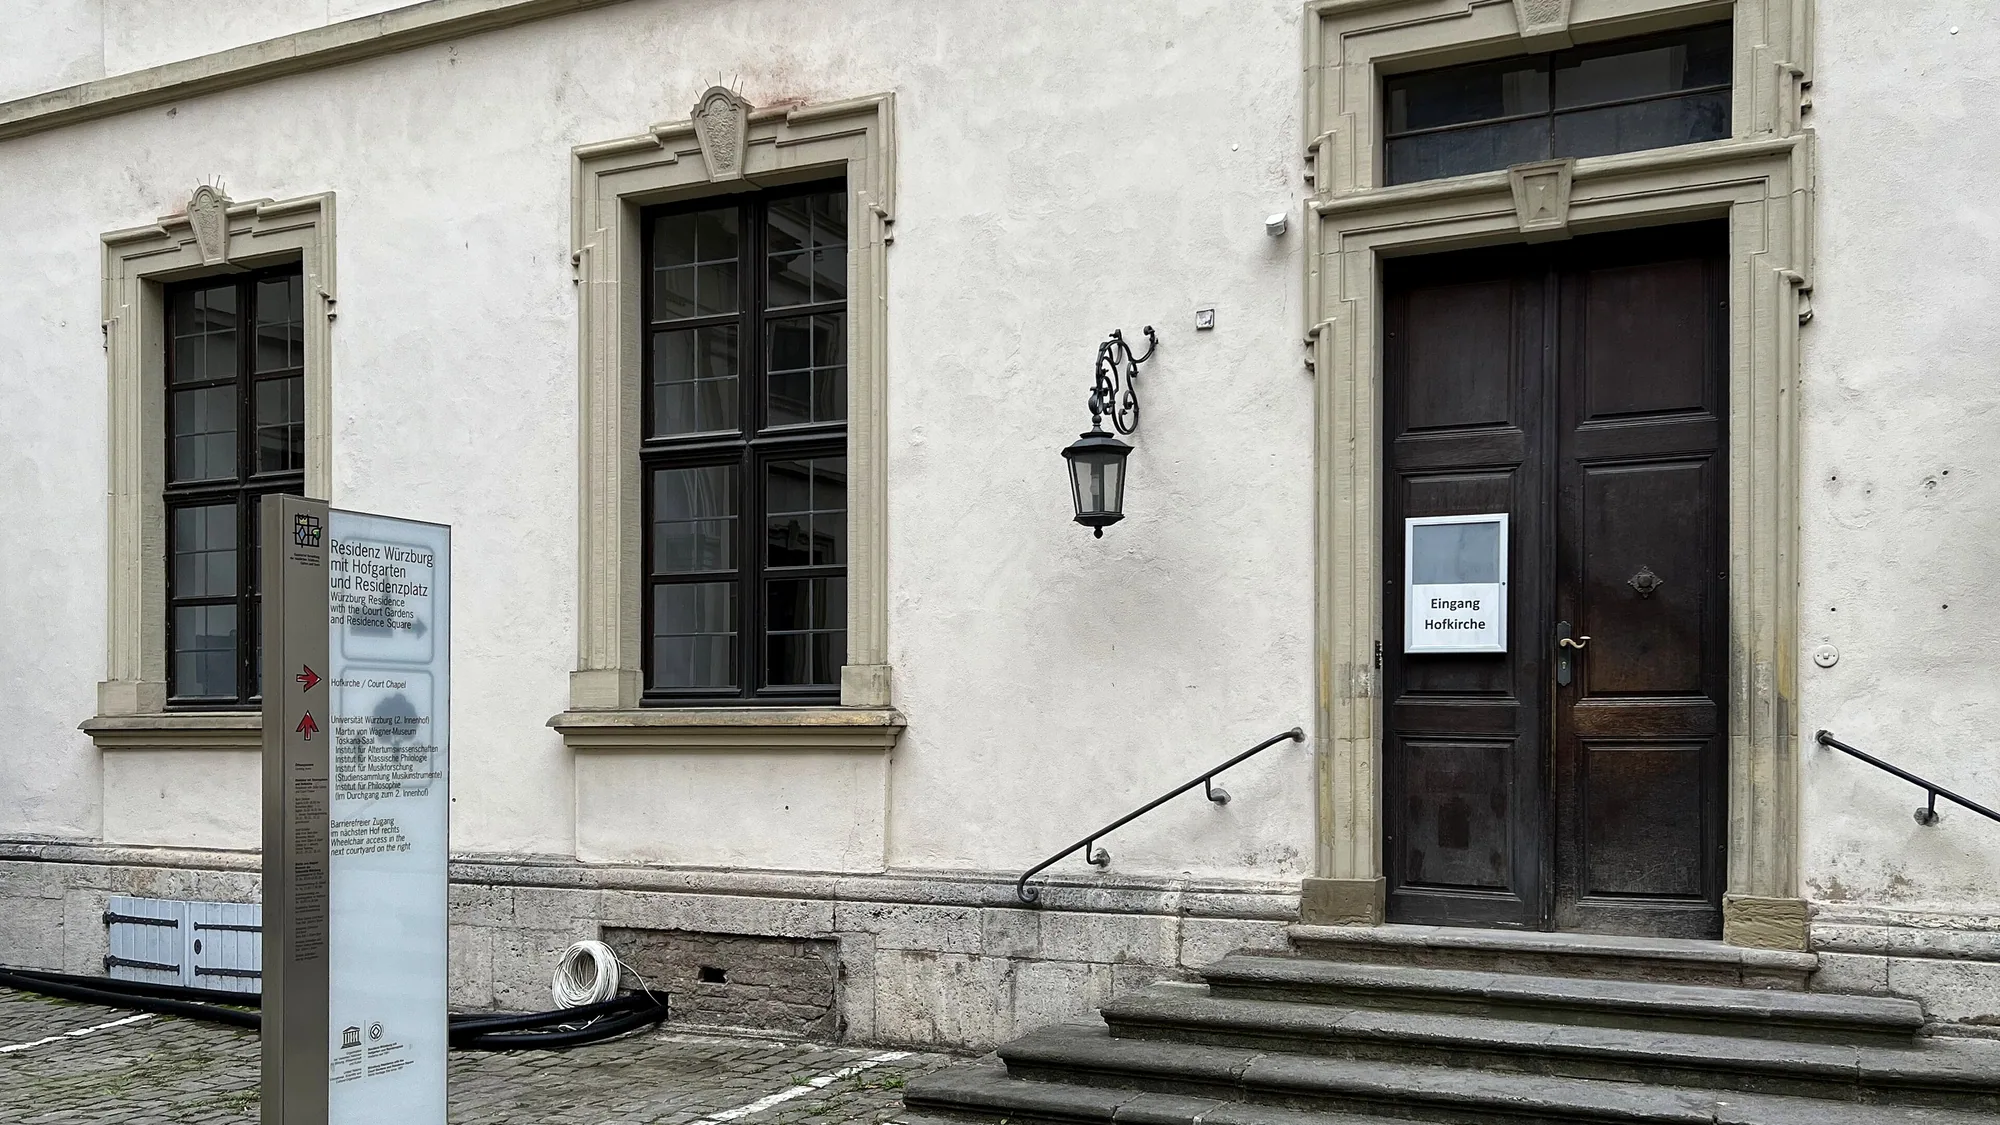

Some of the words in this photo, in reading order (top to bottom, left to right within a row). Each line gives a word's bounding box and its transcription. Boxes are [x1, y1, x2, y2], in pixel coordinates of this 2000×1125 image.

[331, 539, 380, 559] Residenz
[384, 546, 433, 567] Würzburg
[331, 558, 348, 572] mit
[353, 559, 405, 578] Hofgarten
[331, 576, 350, 589] und
[356, 576, 428, 597] Residenzplatz
[331, 592, 365, 605] Würzburg
[369, 595, 405, 607] Residence
[1431, 598, 1480, 611] Eingang
[331, 603, 345, 613] with
[348, 605, 359, 614] the
[362, 606, 382, 616] Court
[385, 607, 413, 618] Gardens
[331, 616, 344, 624] and
[347, 616, 384, 627] Residence
[387, 619, 411, 630] Square
[1425, 618, 1485, 629] Hofkirche
[331, 679, 360, 687] Hofkirche
[386, 680, 406, 689] Chapel
[331, 716, 363, 724] Universität
[365, 716, 392, 725] Würzburg
[404, 716, 429, 724] Innenhof)
[369, 728, 416, 737] Wagner-Museum
[368, 745, 438, 753] Altertumswissenschaften
[358, 755, 366, 763] für
[368, 754, 399, 762] Klassische
[401, 754, 427, 762] Philologie
[368, 764, 413, 772] Musikforschung
[335, 773, 390, 781] (Studiensammlung
[392, 771, 442, 779] Musikinstrumente)
[368, 782, 401, 790] Philosophie
[347, 791, 379, 800] Durchgang
[403, 788, 428, 797] Innenhof)
[331, 819, 370, 828] Barrierefreier
[373, 818, 394, 826] Zugang
[382, 826, 399, 834] rechts
[331, 838, 364, 846] Wheelchair
[366, 836, 387, 845] access
[331, 847, 344, 855] next
[346, 845, 375, 855] courtyard
[397, 843, 410, 852] right
